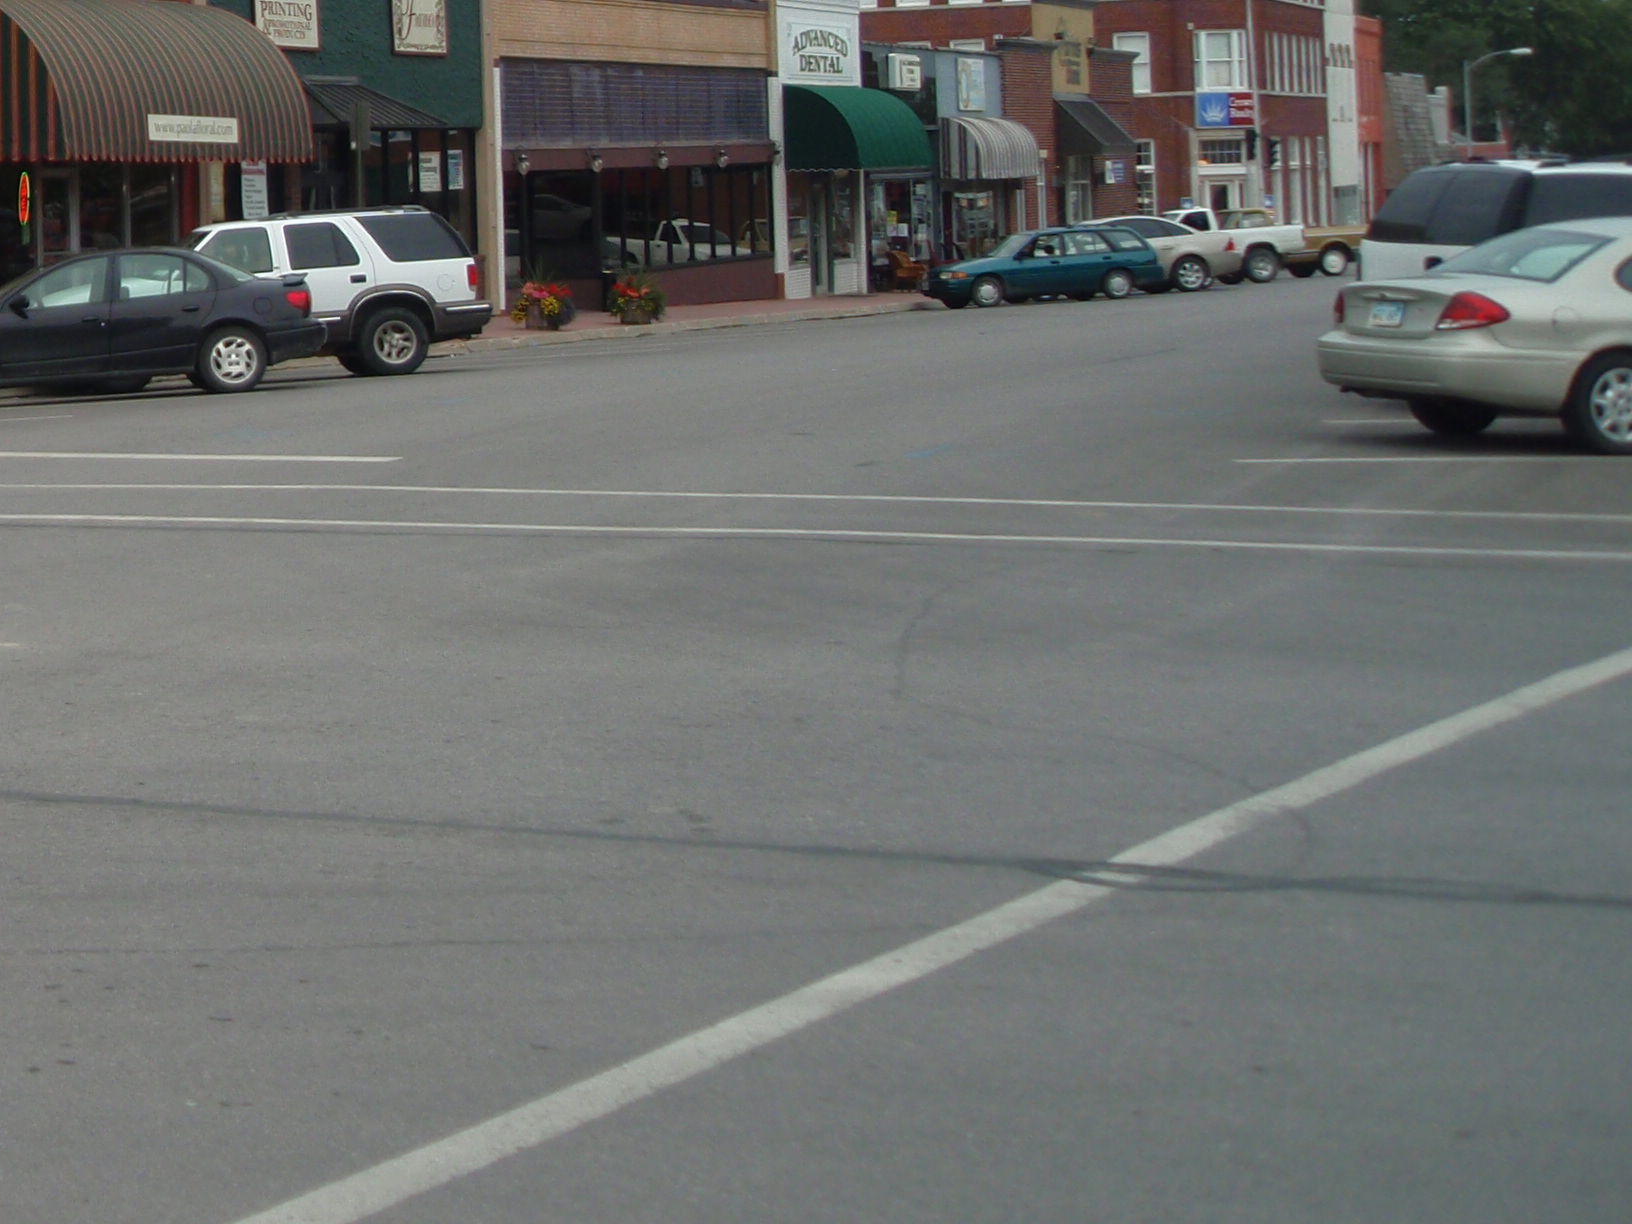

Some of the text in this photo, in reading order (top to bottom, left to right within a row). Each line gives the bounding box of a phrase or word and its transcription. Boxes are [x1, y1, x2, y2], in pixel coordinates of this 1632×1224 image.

[259, 0, 313, 22] PRINTING
[792, 28, 848, 58] ADVANCED
[799, 53, 843, 74] DENTAL
